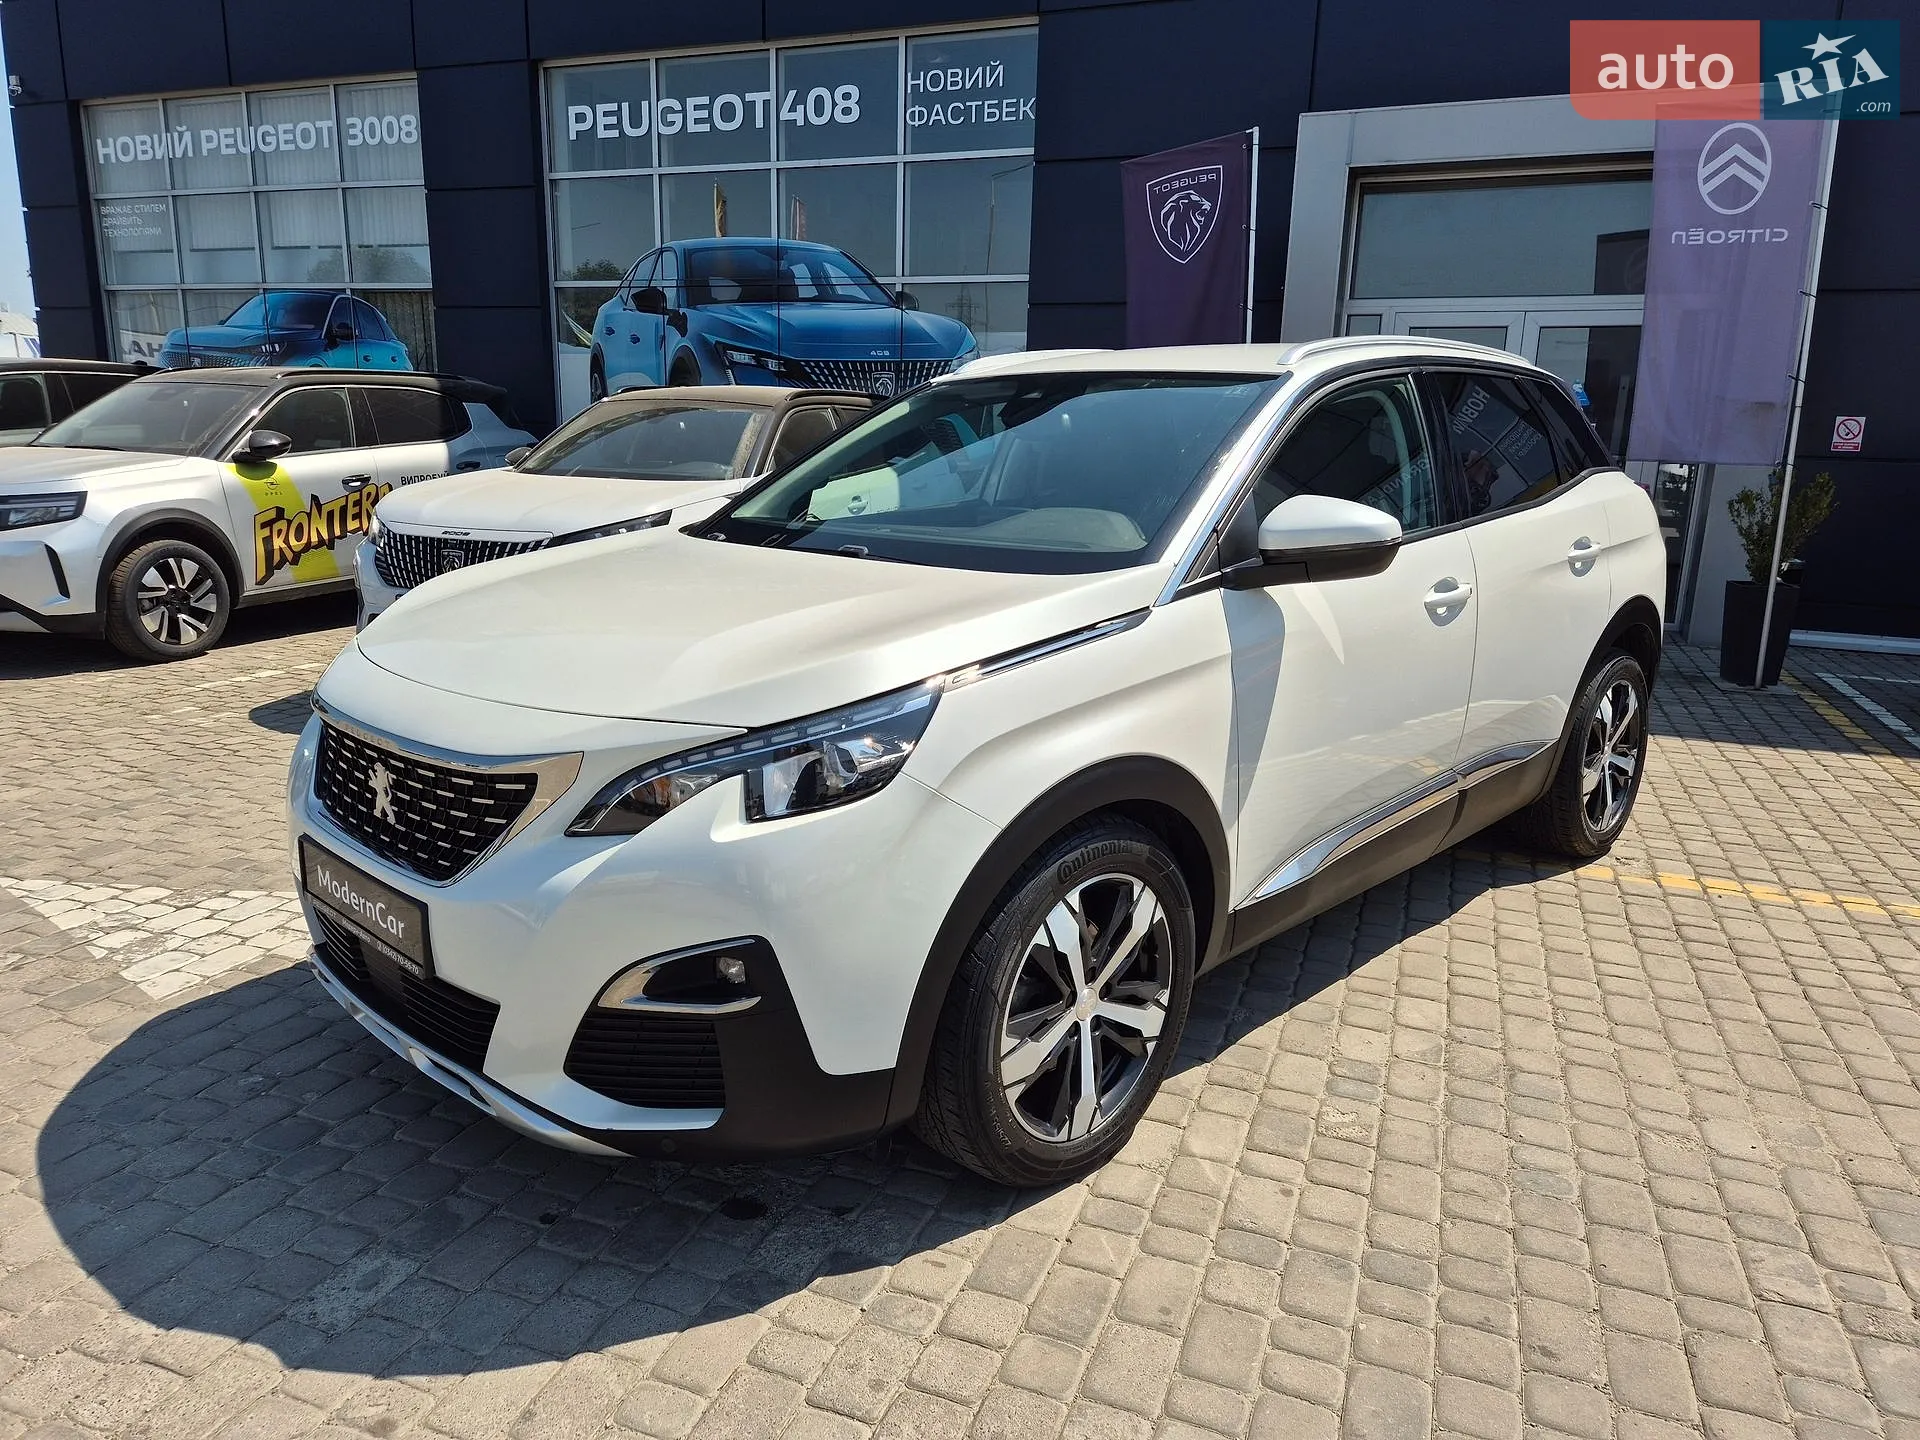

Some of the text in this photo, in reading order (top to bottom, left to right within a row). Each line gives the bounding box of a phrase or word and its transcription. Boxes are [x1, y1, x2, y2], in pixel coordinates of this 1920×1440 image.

[907, 60, 1003, 93] НОВИЙ
[568, 84, 860, 141] PEUGEOT 408
[905, 97, 1036, 127] ФАСТБЕК
[96, 114, 418, 164] НОВИЙ PEUGEOT 3008
[317, 865, 405, 938] ModernCar
